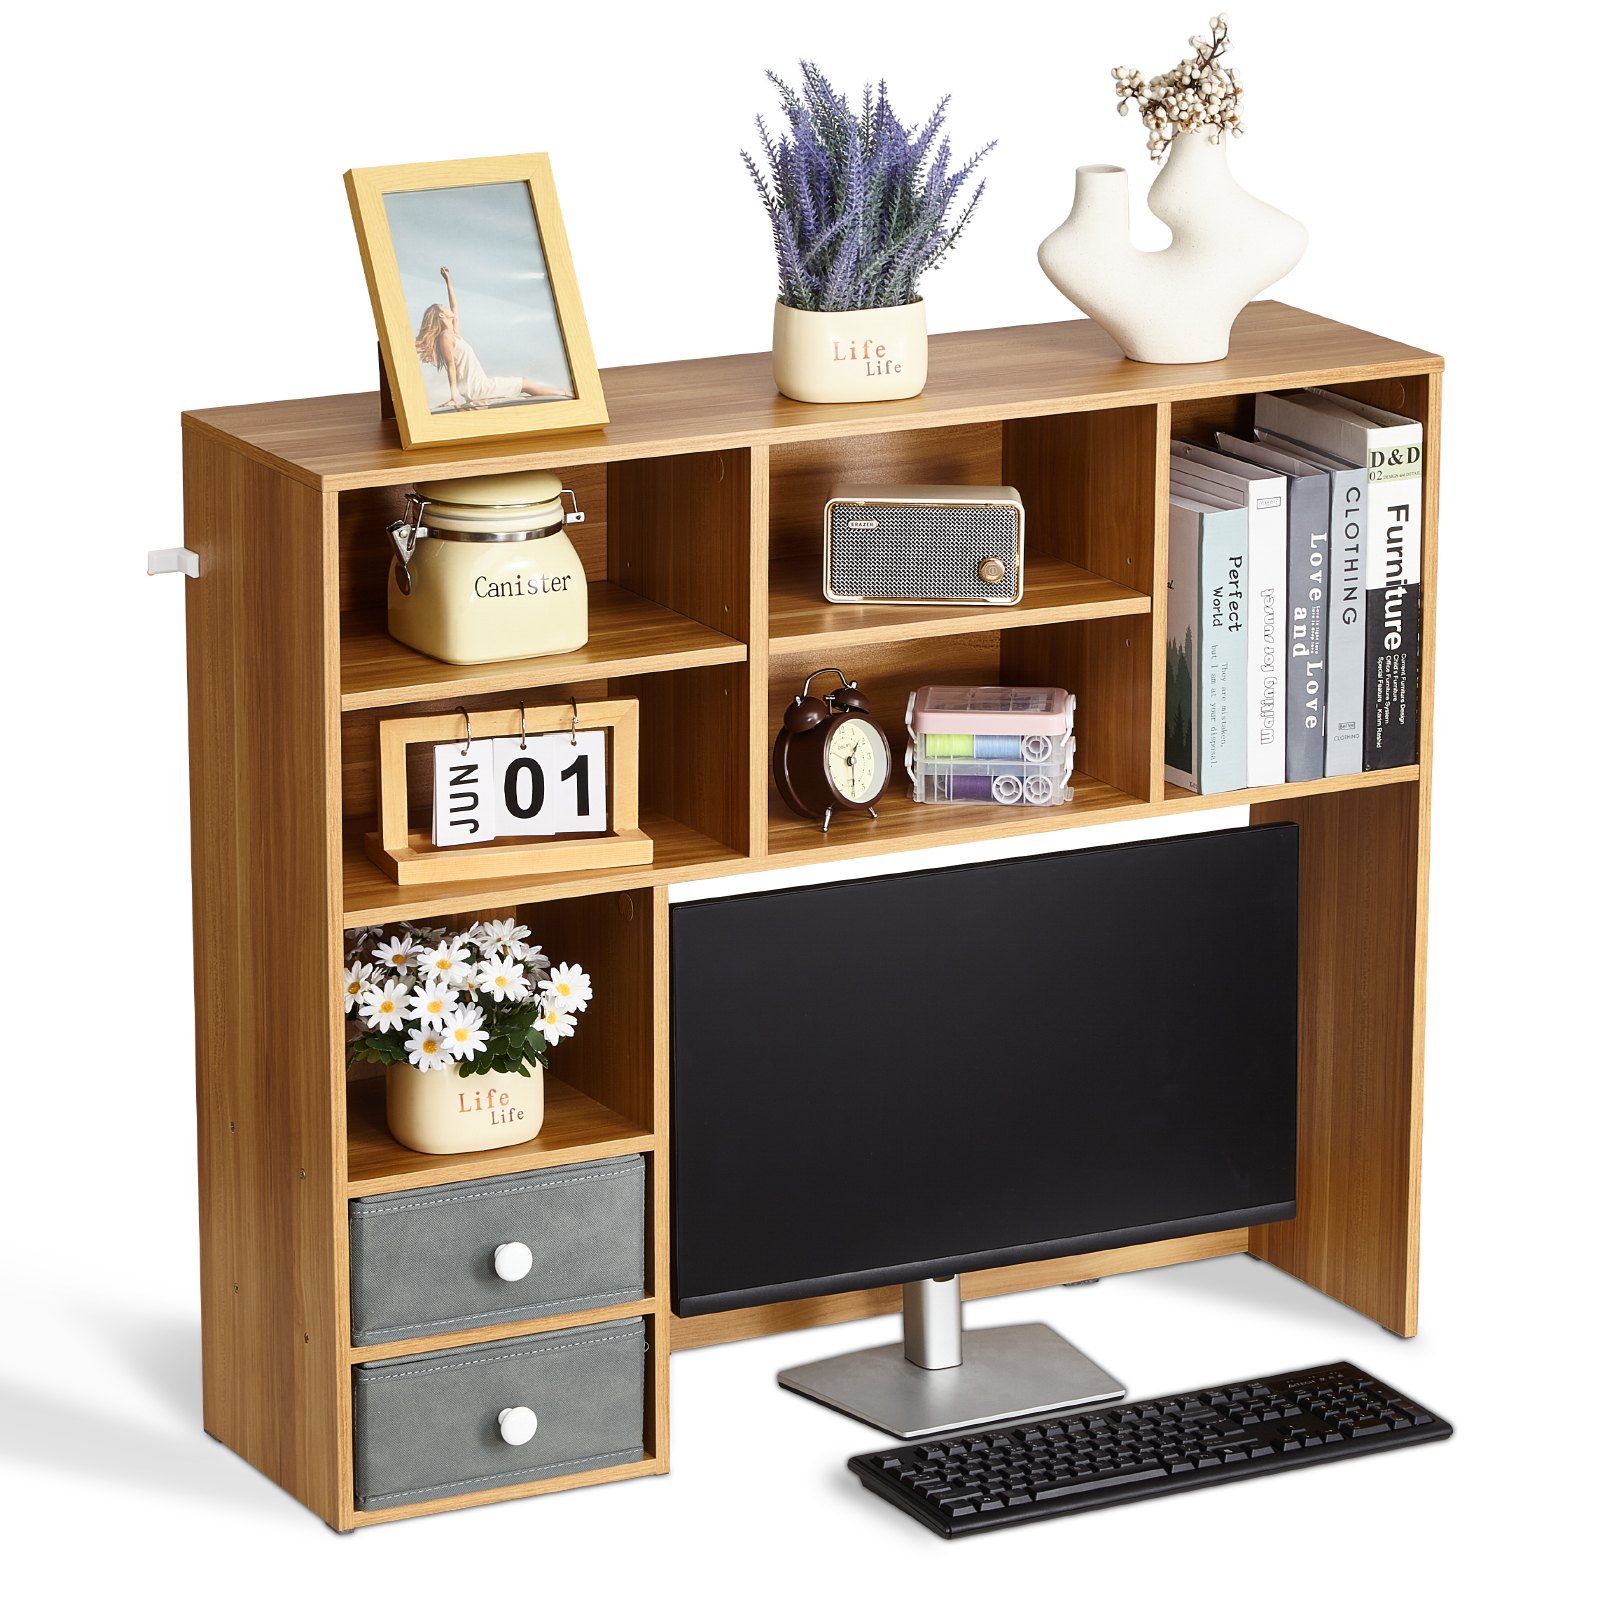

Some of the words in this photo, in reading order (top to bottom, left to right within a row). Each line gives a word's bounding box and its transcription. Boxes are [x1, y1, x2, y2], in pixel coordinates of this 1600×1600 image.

[833, 339, 886, 361] Life
[866, 360, 902, 376] Life
[1369, 470, 1383, 481] 02
[1308, 532, 1327, 601] Love
[1342, 486, 1361, 625] CLOTHING
[474, 573, 571, 598] Canister
[1228, 555, 1242, 632] Perfect
[1384, 504, 1409, 650] Furniture
[1212, 586, 1223, 627] World
[1261, 588, 1274, 643] sunset
[1293, 607, 1309, 657] and
[1220, 663, 1228, 682] They
[1261, 647, 1274, 672] for
[1211, 673, 1217, 685] am
[1211, 688, 1217, 697] at
[1305, 660, 1323, 729] Love
[1261, 676, 1277, 745] Waiting
[449, 763, 480, 834] JUN
[458, 1088, 510, 1113] Life
[491, 1108, 524, 1126] Life
